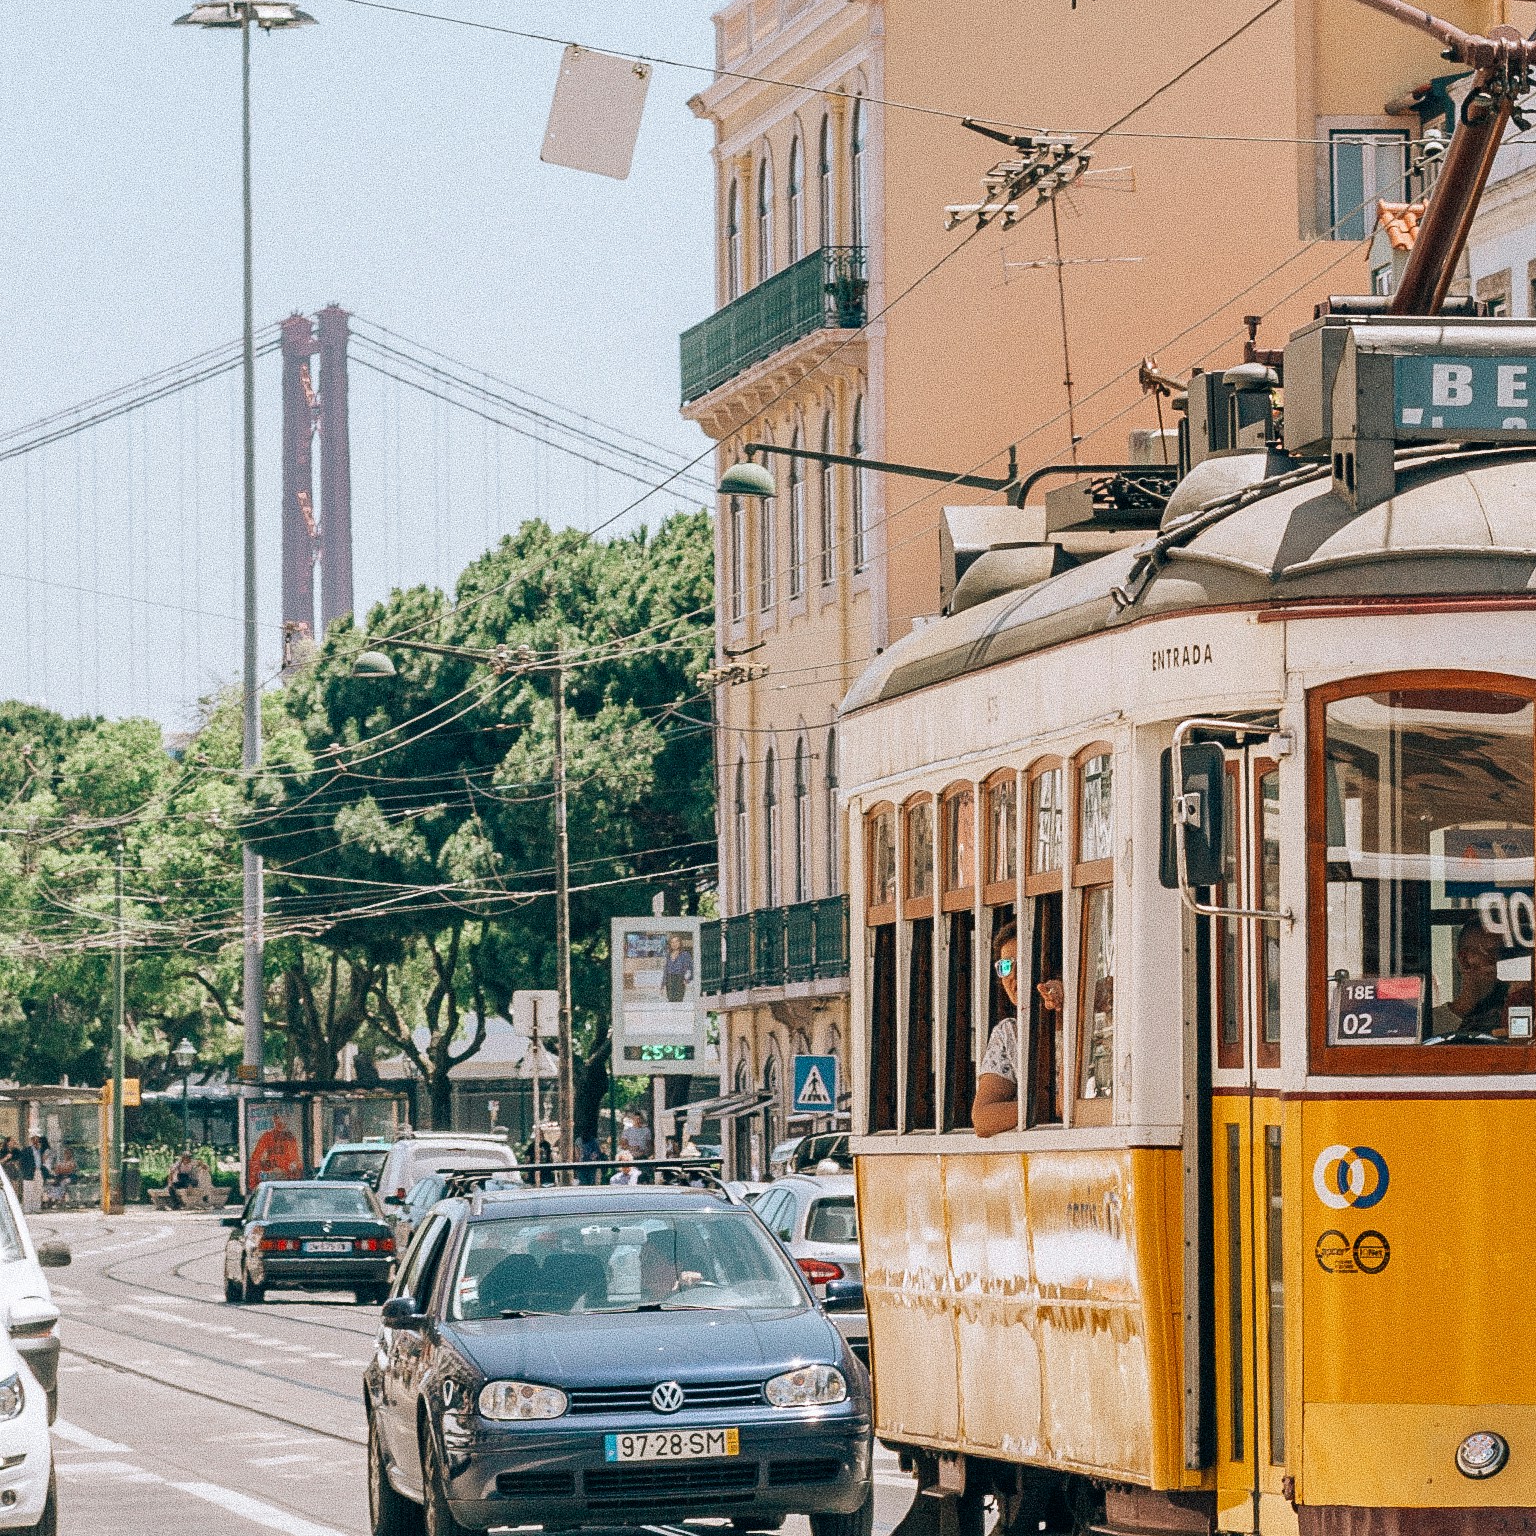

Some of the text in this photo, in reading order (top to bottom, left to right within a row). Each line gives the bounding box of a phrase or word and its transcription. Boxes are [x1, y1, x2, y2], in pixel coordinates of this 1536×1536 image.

[1152, 644, 1213, 671] ENTRADA
[1346, 985, 1375, 1000] 18E
[1342, 1013, 1373, 1035] 02
